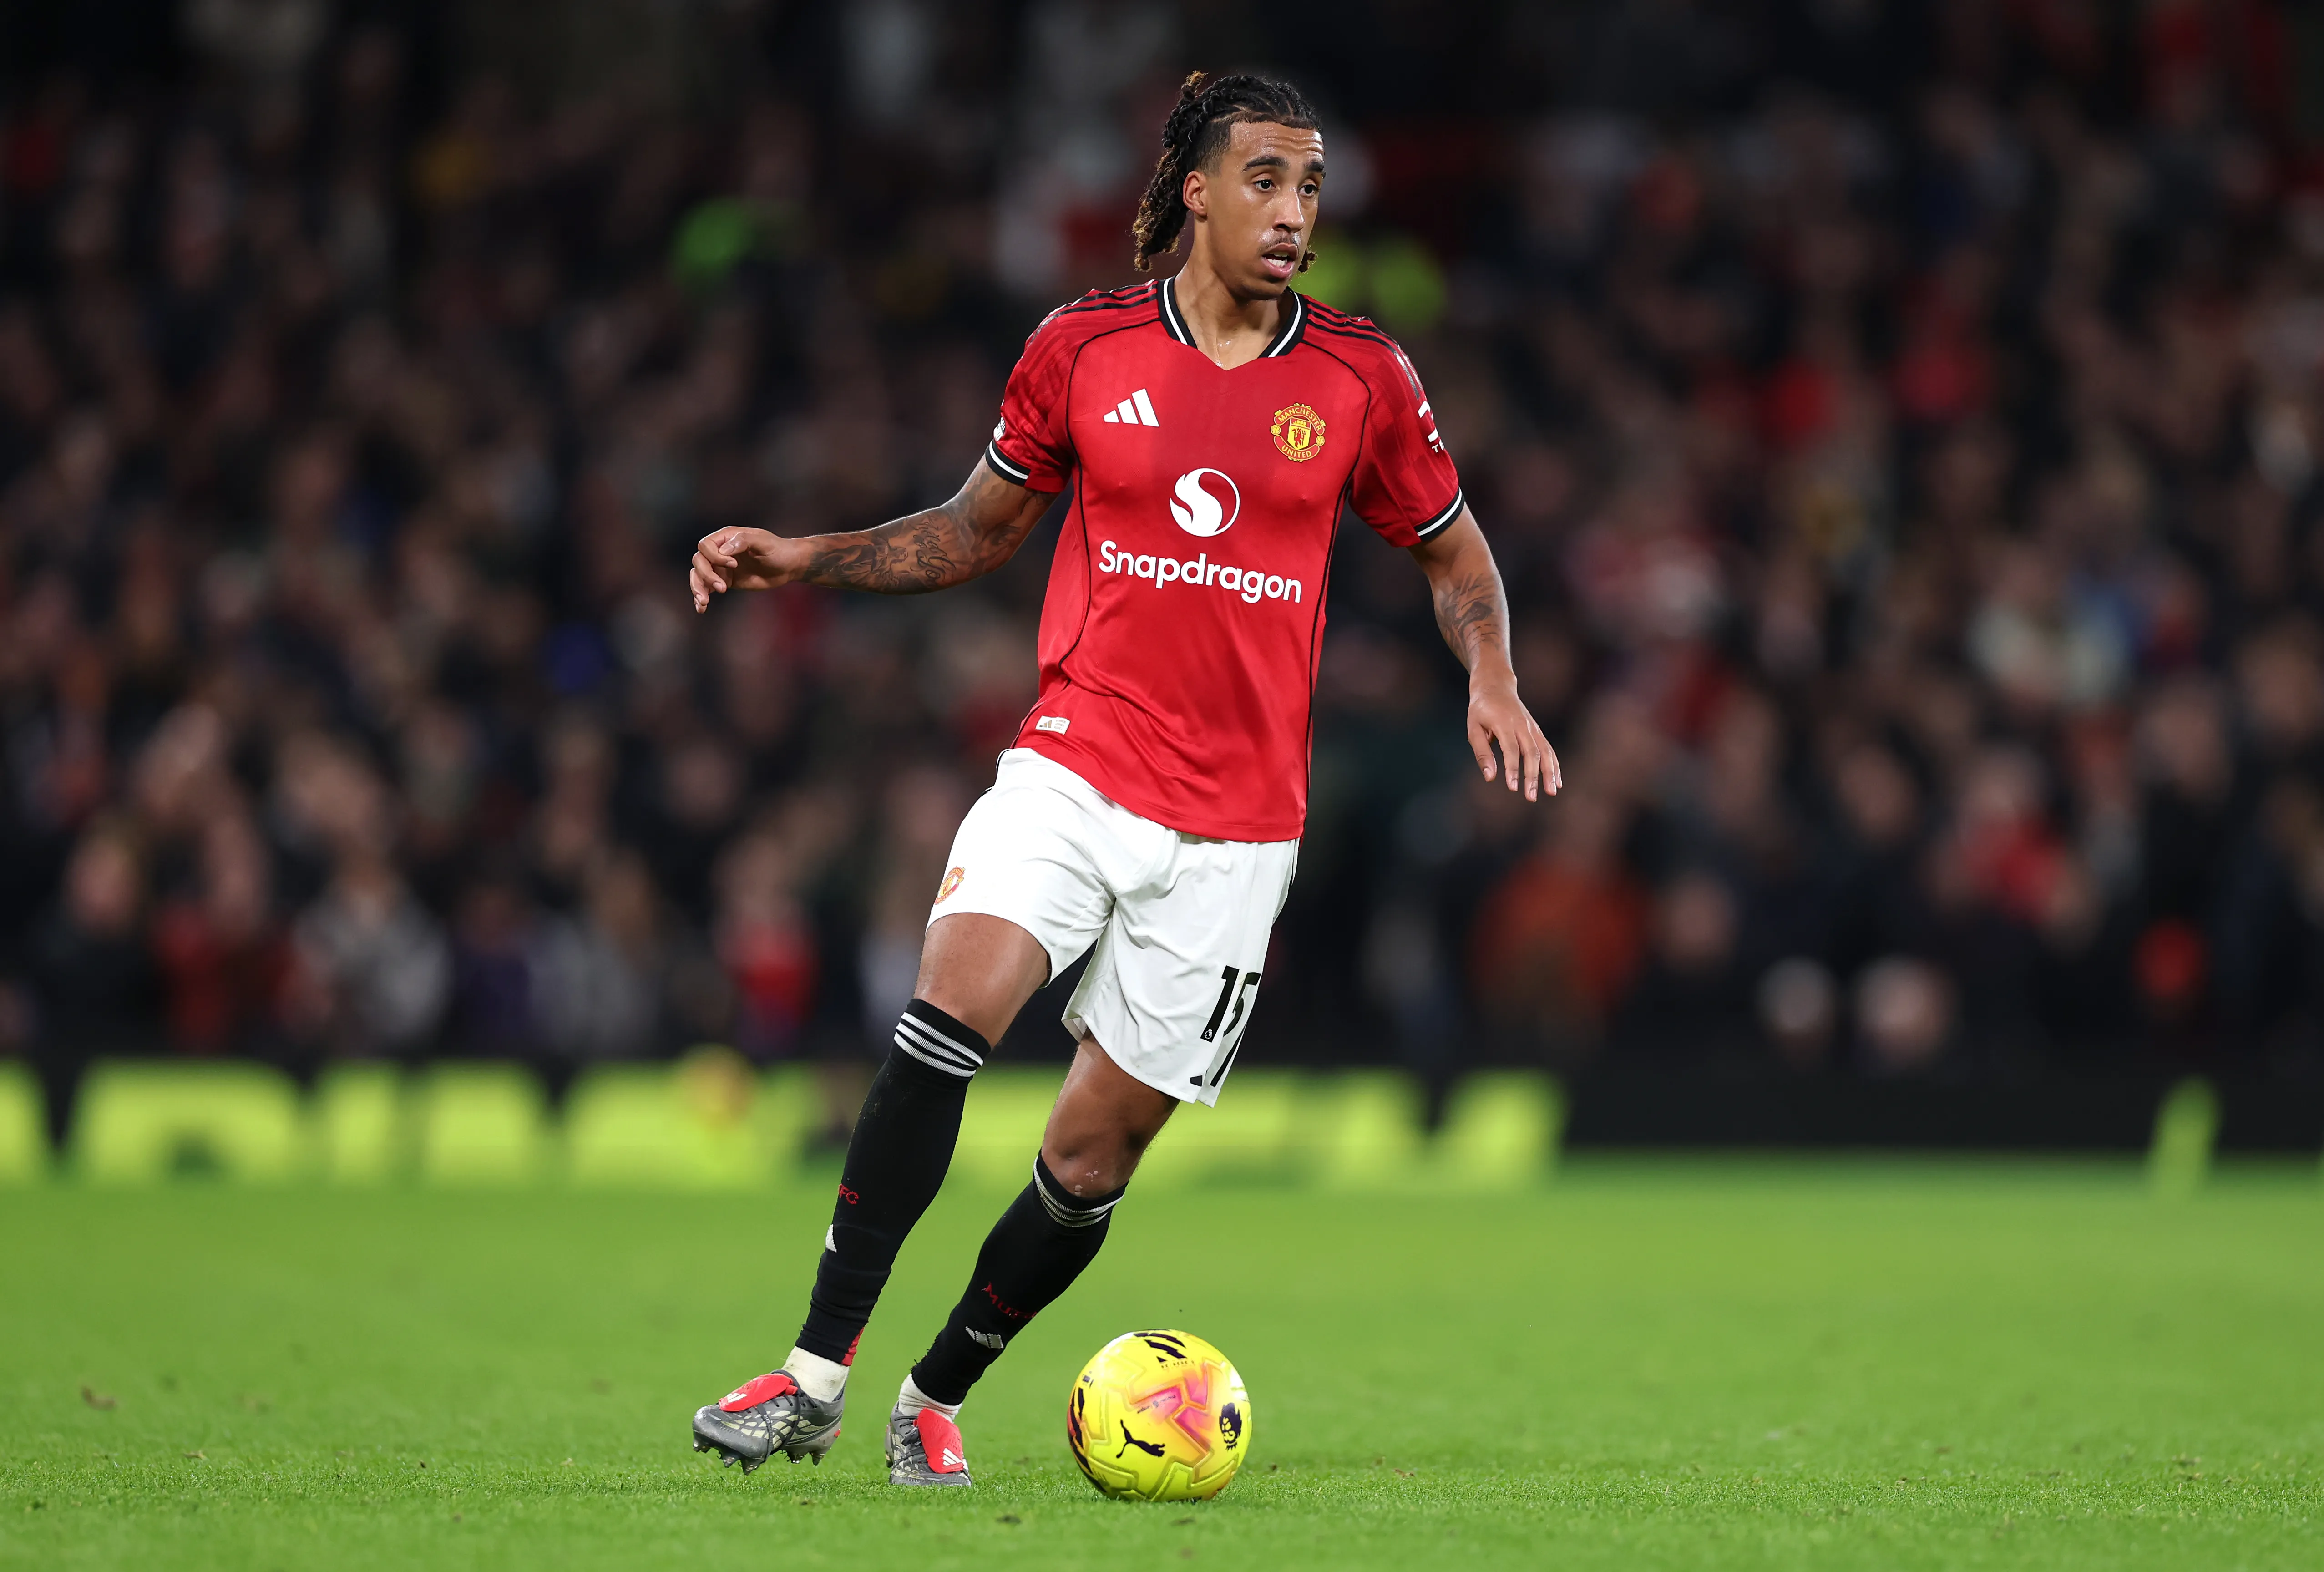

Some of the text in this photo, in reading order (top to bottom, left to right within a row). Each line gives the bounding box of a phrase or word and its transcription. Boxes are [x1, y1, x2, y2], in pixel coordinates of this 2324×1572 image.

[1278, 407, 1322, 431] MANCHESTER
[1281, 445, 1311, 459] UNITED
[1099, 540, 1301, 603] Snapdragon
